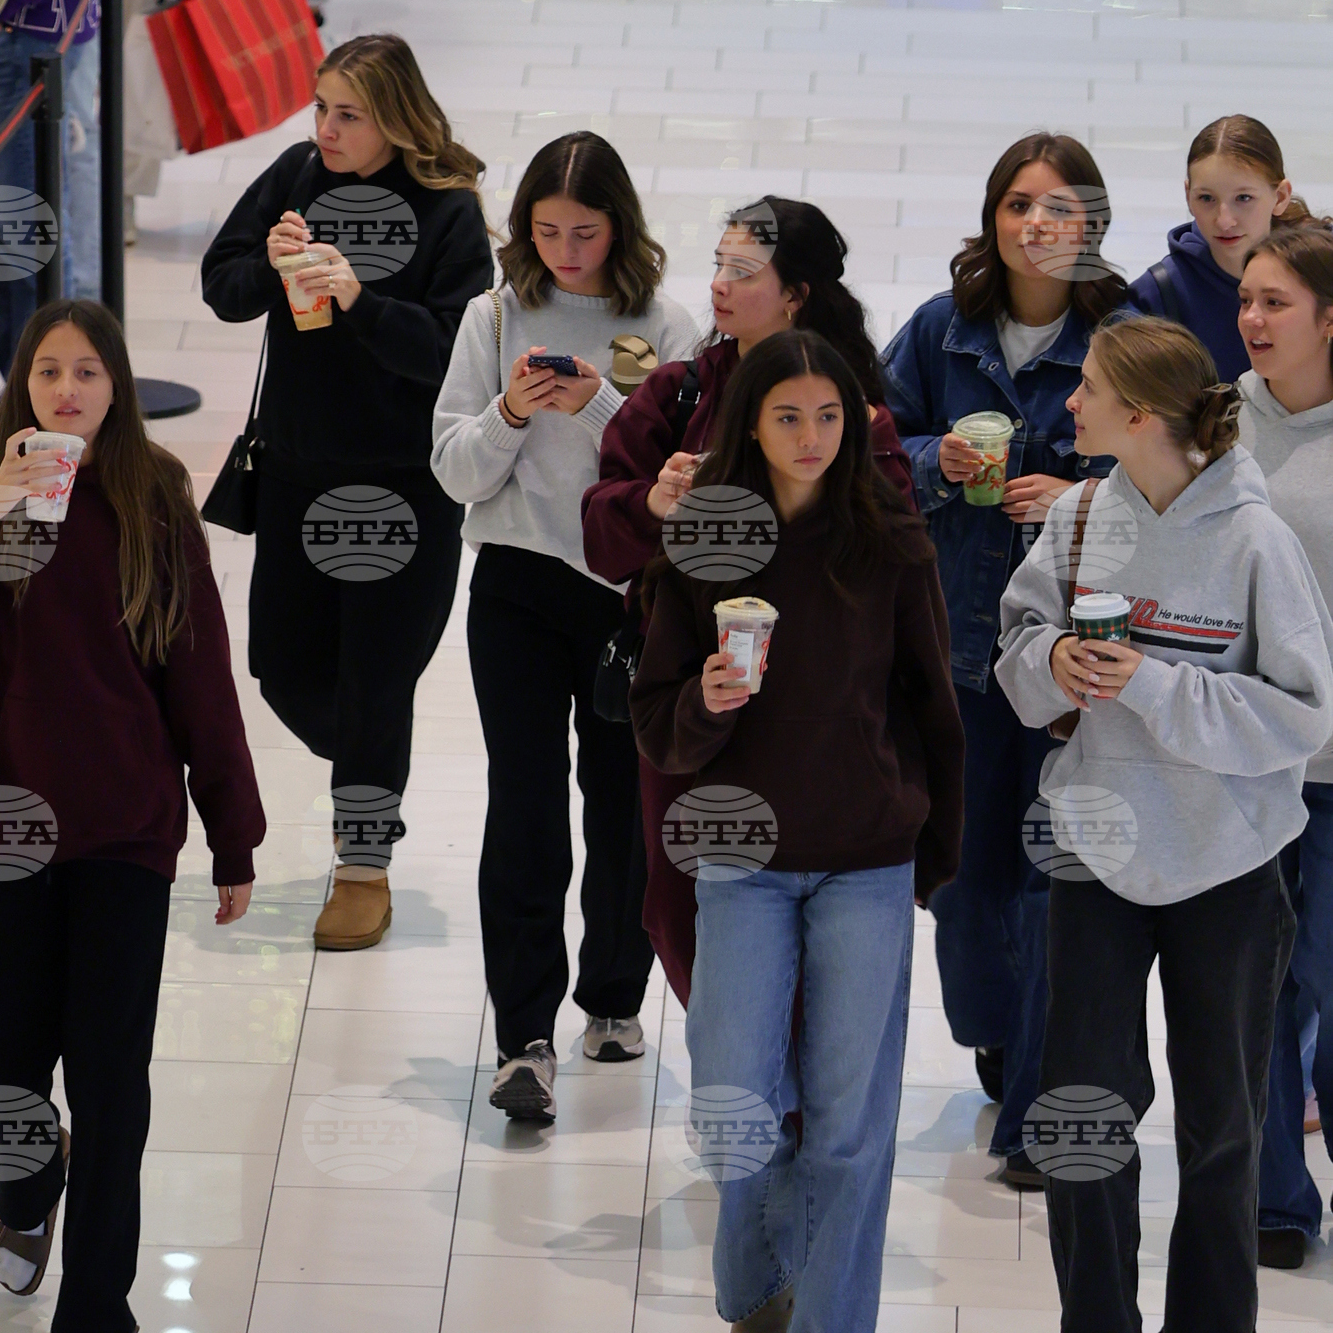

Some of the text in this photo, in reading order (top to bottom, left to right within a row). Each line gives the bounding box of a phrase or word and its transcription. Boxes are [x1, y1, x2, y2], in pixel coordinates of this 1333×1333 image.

[1158, 609, 1171, 620] He
[1173, 612, 1202, 624] would
[1203, 615, 1223, 627] love
